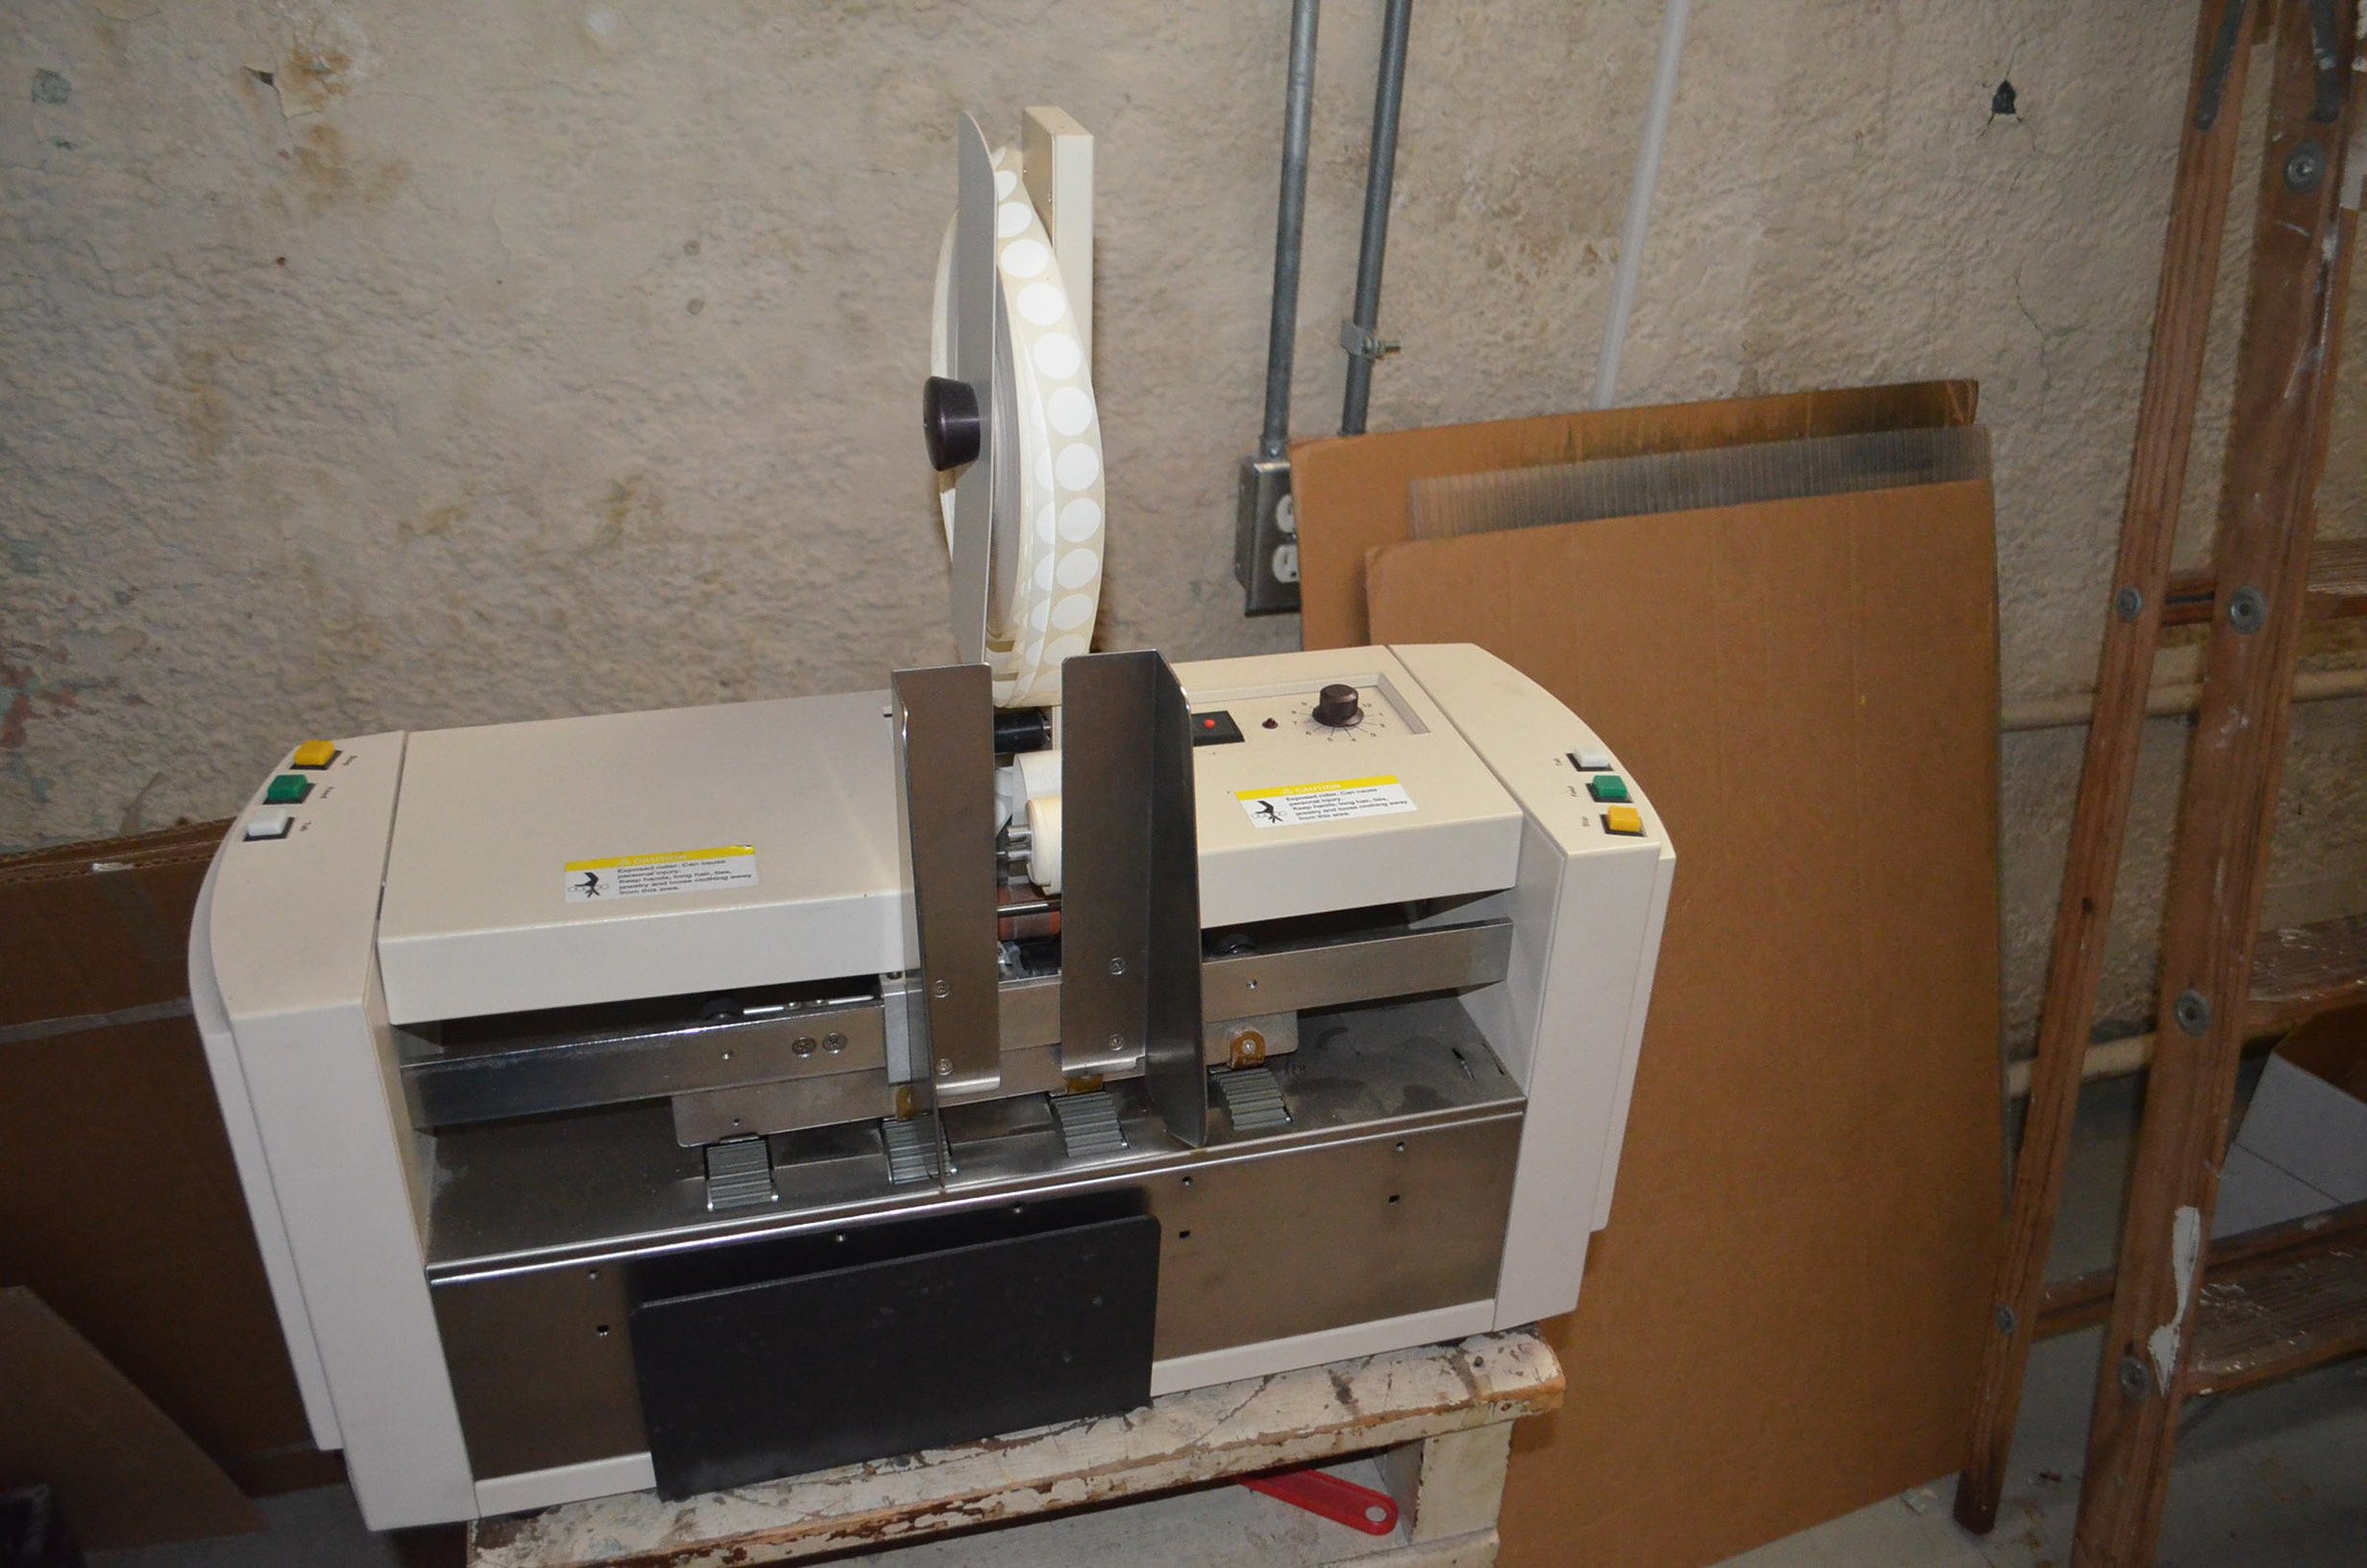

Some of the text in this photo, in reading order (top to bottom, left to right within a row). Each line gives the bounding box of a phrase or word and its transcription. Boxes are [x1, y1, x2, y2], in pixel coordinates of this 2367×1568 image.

[1295, 784, 1342, 794] CAUTION
[617, 865, 655, 874] Exposed
[693, 875, 729, 884] clothing
